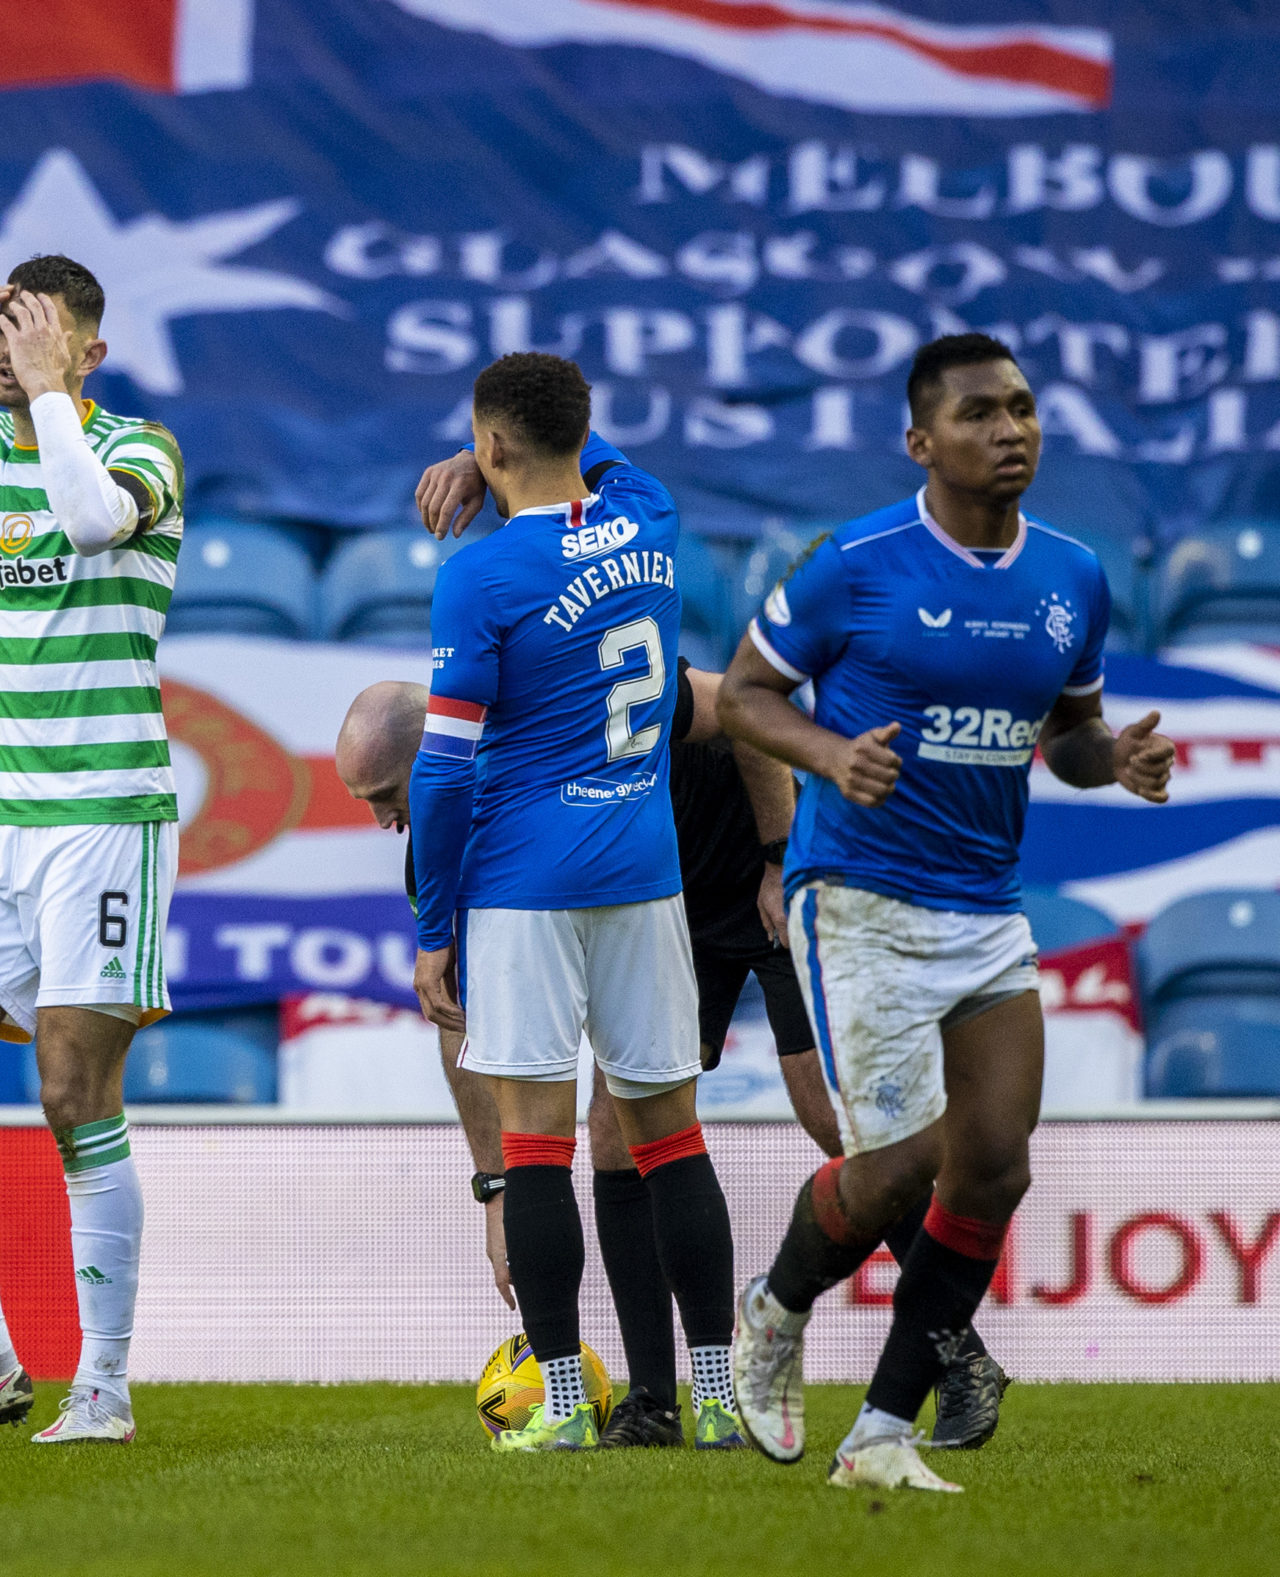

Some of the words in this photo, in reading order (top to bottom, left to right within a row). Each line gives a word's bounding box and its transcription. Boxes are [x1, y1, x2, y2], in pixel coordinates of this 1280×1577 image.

[561, 516, 639, 558] SEKO
[543, 551, 675, 633] TAVERNIER
[598, 615, 666, 763] 2
[98, 889, 130, 949] 6
[100, 970, 126, 979] adidas
